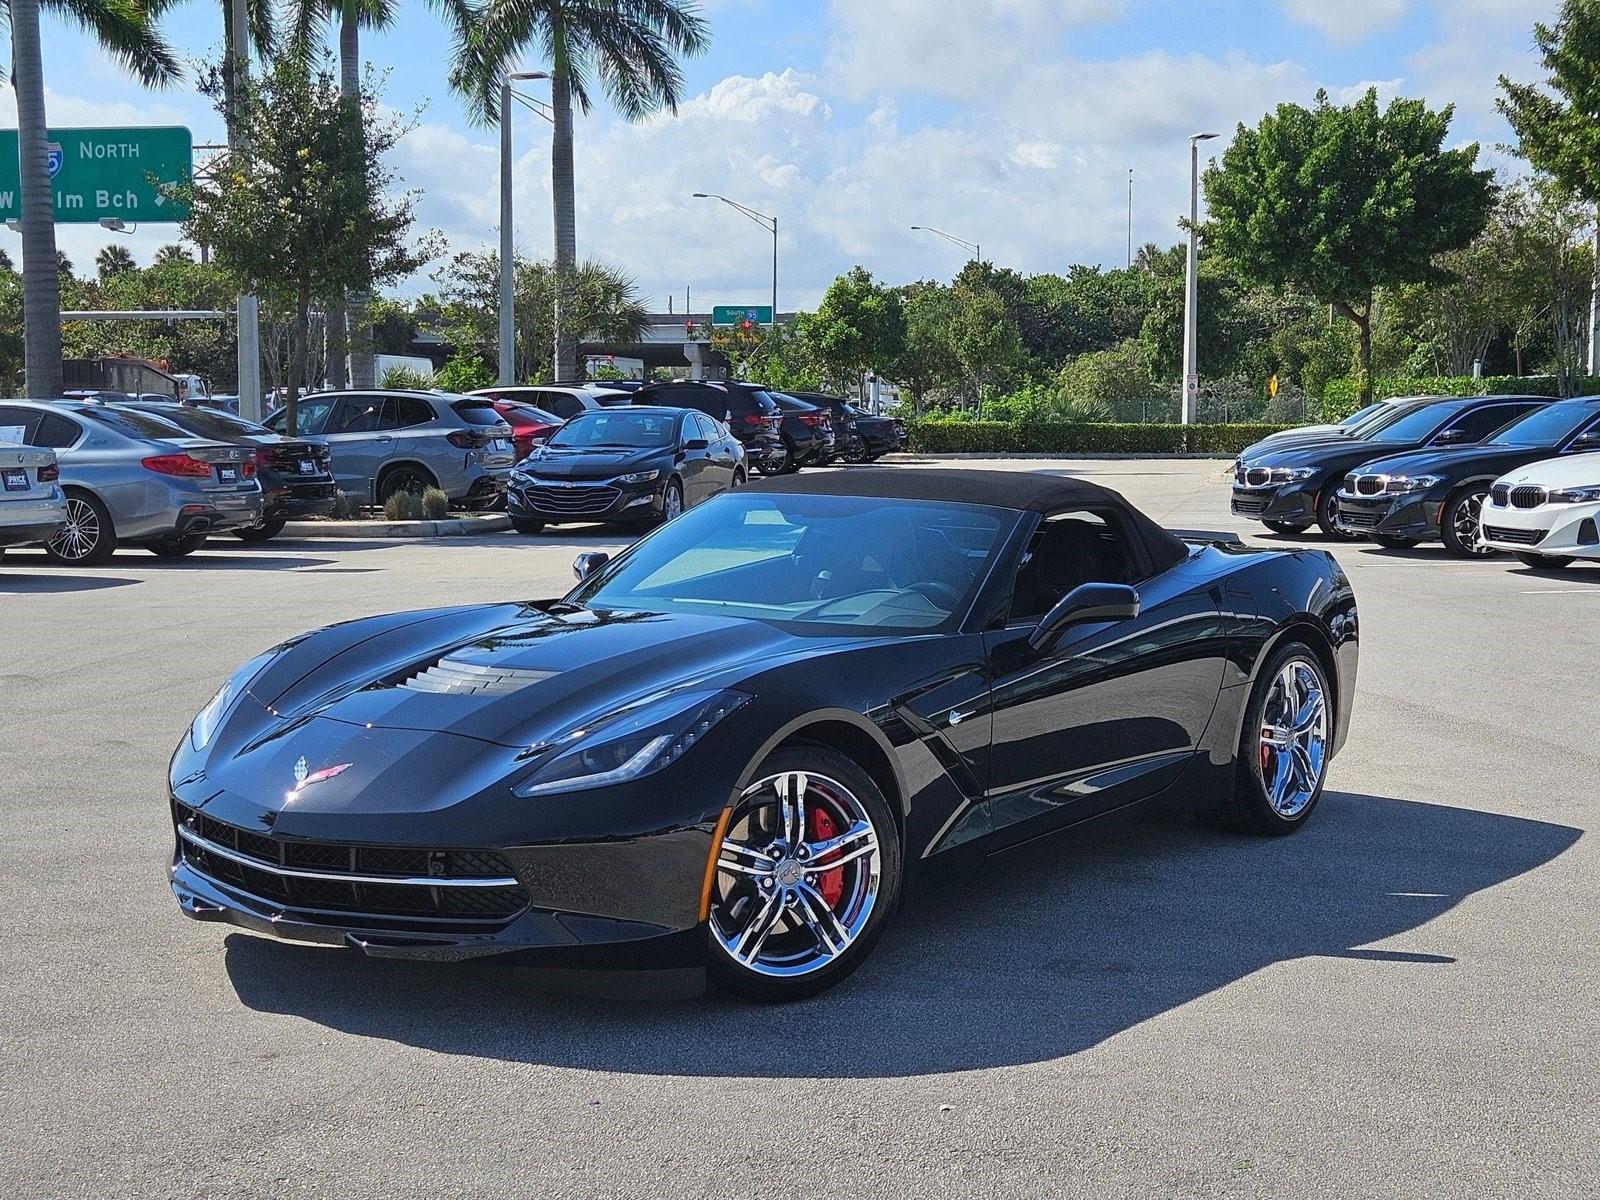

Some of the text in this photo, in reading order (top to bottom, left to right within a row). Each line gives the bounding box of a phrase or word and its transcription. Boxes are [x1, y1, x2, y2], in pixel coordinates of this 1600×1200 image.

[47, 141, 139, 171] 5 NORTH
[96, 189, 138, 208] Bch
[8, 475, 27, 483] PRICE
[221, 469, 235, 477] PRICE
